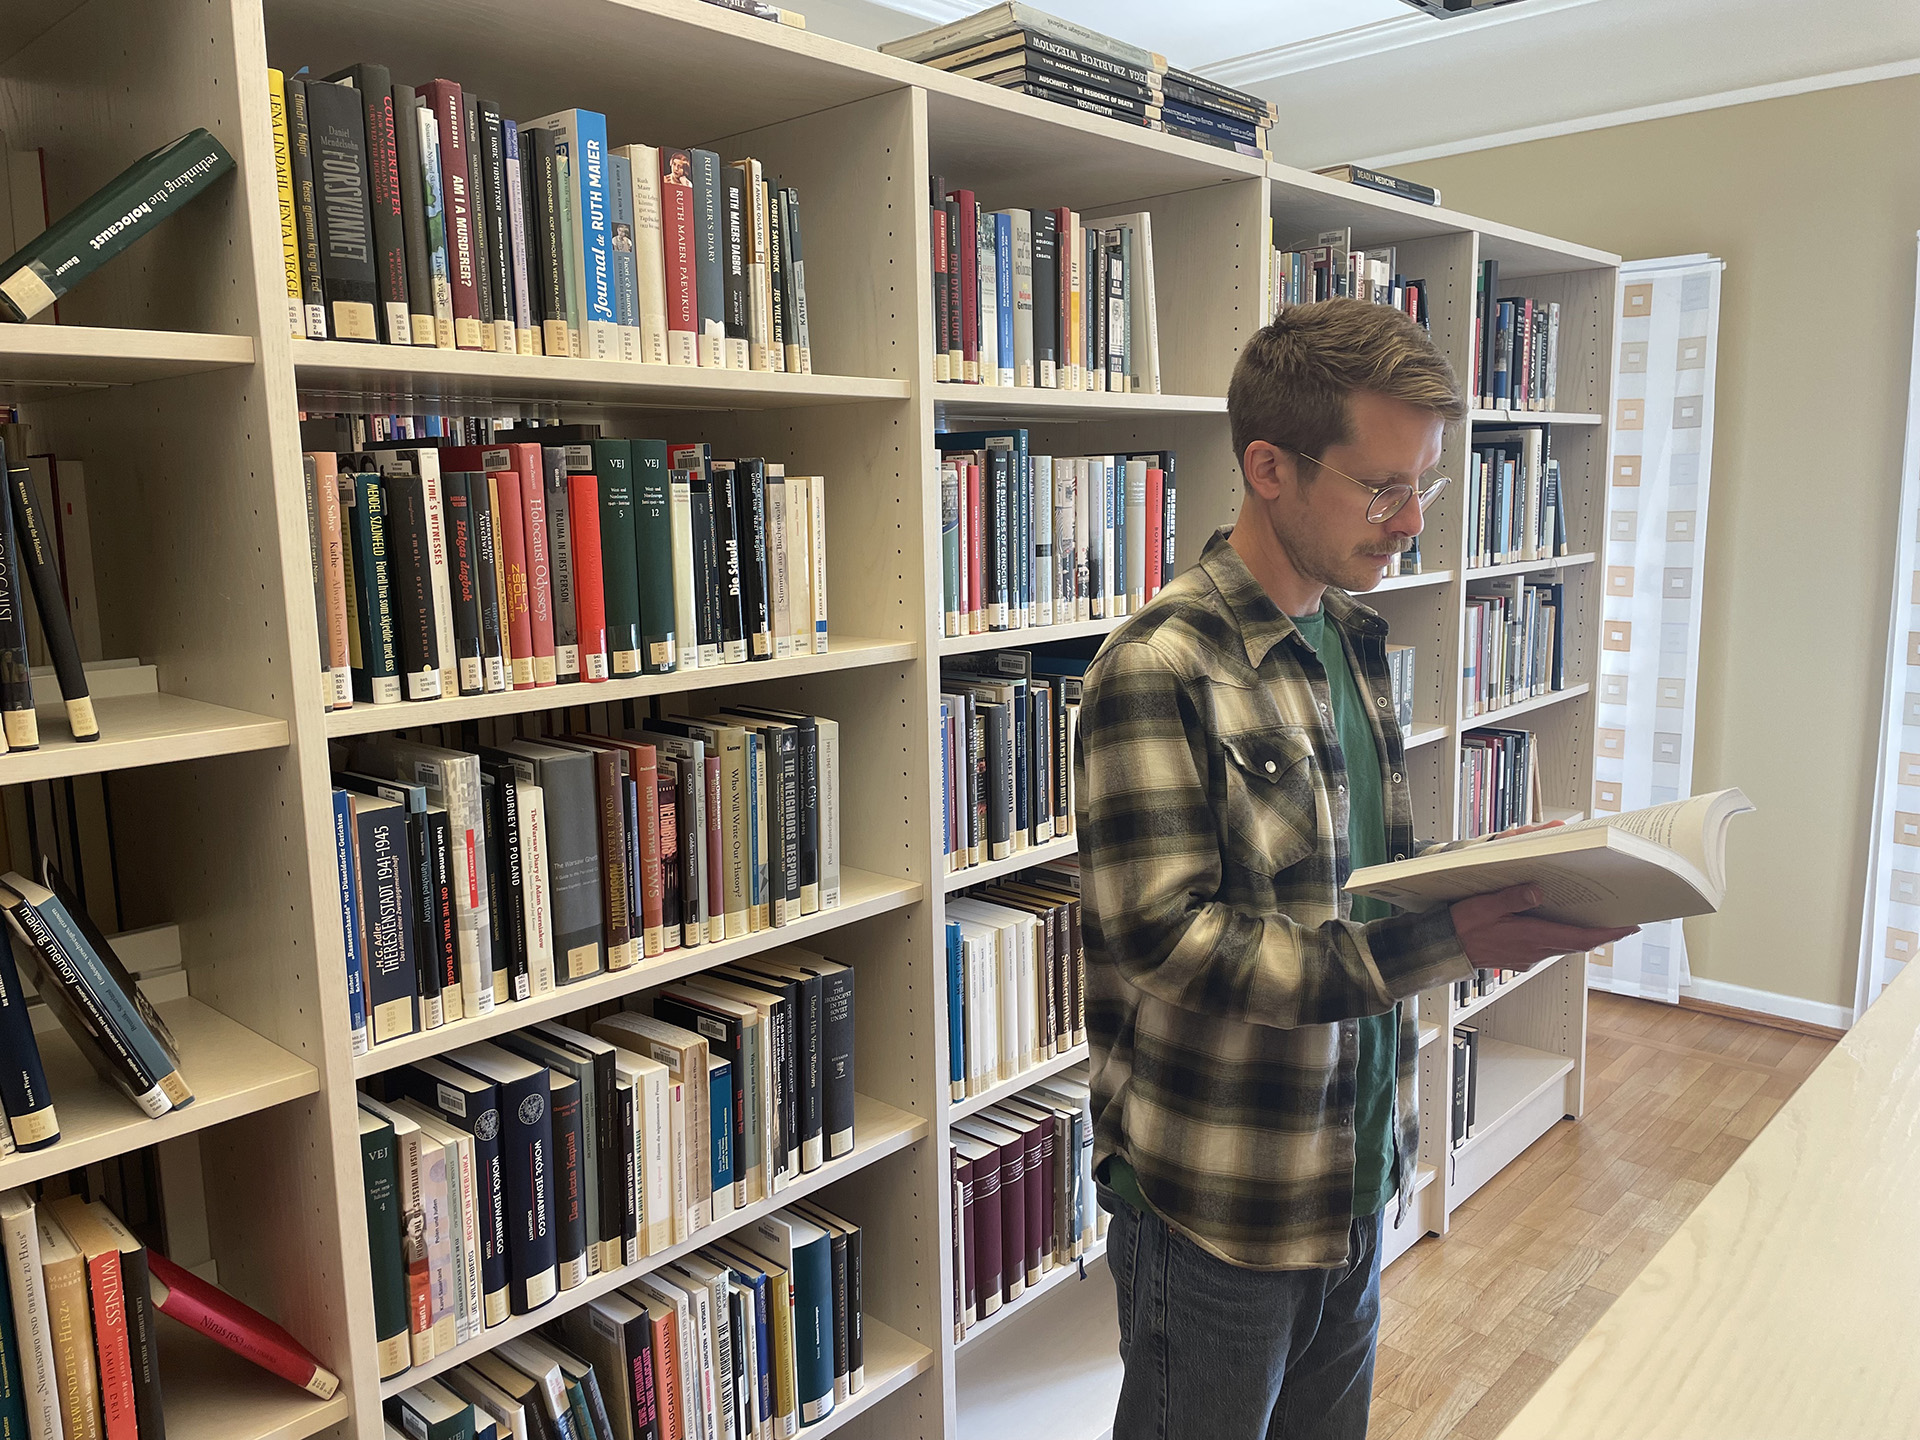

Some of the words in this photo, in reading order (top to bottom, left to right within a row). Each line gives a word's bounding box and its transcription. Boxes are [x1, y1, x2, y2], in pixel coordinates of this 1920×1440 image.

[1042, 57, 1053, 66] THE
[1054, 62, 1089, 77] AUSCHWITZ
[1090, 73, 1110, 84] ALBUM
[1039, 75, 1068, 90] AUSCHWITZ
[1073, 86, 1083, 94] THE
[1084, 88, 1110, 102] RESIDENCE
[1110, 95, 1116, 103] OF
[1117, 98, 1134, 109] DEATH
[1076, 98, 1112, 116] MAUTHAUSEN
[328, 125, 350, 138] Daniel
[449, 95, 459, 149] PERECHODNIK
[320, 136, 359, 150] Mendelsohn
[383, 96, 401, 216] COUNTERFEITER
[511, 128, 519, 158] palgrave
[164, 151, 220, 194] rethinking
[587, 139, 601, 187] MAIER
[148, 188, 169, 205] the
[1374, 175, 1396, 188] MEDICINE
[322, 150, 367, 263] FORSVUNNET
[589, 190, 605, 231] RUTH
[676, 190, 684, 222] RUTH
[706, 188, 714, 231] MAIER'S
[730, 187, 739, 210] RUTH
[771, 198, 779, 227] ROBERT
[88, 201, 153, 251] holocaust
[597, 234, 604, 246] de
[730, 211, 741, 243] MAIERS
[677, 224, 686, 264] MAIERI
[707, 232, 715, 264] DIARY
[772, 229, 780, 273] SAVOSNICK
[55, 255, 81, 277] Bauer
[731, 244, 741, 276] DAGBOK
[950, 253, 958, 276] DEN
[592, 248, 612, 318] Journal
[680, 266, 689, 322] PÄEVIKUD
[773, 288, 781, 302] JEG
[951, 278, 959, 306] DYRE
[774, 303, 782, 324] VILLE
[952, 309, 960, 342] FLUGT
[610, 459, 625, 469] VEJ
[644, 459, 660, 469] VEJ
[18, 482, 28, 505] WAXMAN
[366, 483, 381, 514] MENDEL
[427, 478, 440, 511] TIME'S
[25, 507, 36, 528] Writing
[530, 498, 545, 561] Holocaust
[555, 509, 565, 538] TRAUMA
[774, 501, 782, 550] Buchenwald
[31, 529, 39, 538] the
[369, 516, 385, 557] SZAJNFELD
[429, 514, 442, 565] WITNESSES
[455, 520, 468, 557] Helgas
[479, 513, 489, 560] Auschwitz
[556, 541, 566, 550] IN
[1001, 534, 1006, 545] OF
[32, 538, 44, 565] Holocaust
[412, 533, 421, 568] smoke
[557, 552, 568, 572] FIRST
[726, 539, 738, 575] Schuld
[375, 561, 388, 584] Fortell
[416, 576, 424, 600] over
[459, 561, 472, 602] dagbok
[511, 563, 522, 613] ZSOLT
[728, 577, 740, 596] Die
[777, 568, 785, 604] Stimmen
[377, 585, 389, 598] hva
[534, 565, 548, 622] Odysseys
[558, 574, 570, 603] PERSON
[379, 599, 389, 614] som
[381, 615, 393, 643] skjedde
[419, 608, 430, 659] birkenau
[383, 643, 394, 658] med
[386, 660, 394, 672] oss
[784, 758, 795, 778] THE
[806, 744, 816, 782] Secret
[731, 768, 740, 791] Who
[505, 783, 517, 828] JOURNEY
[605, 795, 614, 828] TOWN
[732, 794, 741, 812] Will
[785, 782, 796, 840] NEIGHBORS
[806, 785, 817, 809] City
[508, 831, 517, 844] TO
[659, 802, 677, 855] NEIGHBORS
[732, 813, 741, 839] Write
[373, 825, 392, 881] 1941-1945
[607, 831, 617, 862] NEAR
[733, 840, 741, 860] Our
[421, 860, 431, 894] Vanished
[510, 847, 520, 886] POLAND
[733, 861, 742, 898] History?
[786, 844, 797, 891] RESPOND
[391, 855, 403, 915] Zwangsgemeinschaft
[610, 863, 626, 930] AUSCHWITZ
[422, 896, 432, 923] History
[19, 905, 51, 946] making
[44, 943, 78, 986] memory
[373, 922, 383, 946] Adler
[378, 885, 399, 975] THERESIENSTADT
[375, 947, 384, 968] H.G.
[810, 1020, 818, 1034] His
[809, 1036, 818, 1052] Very
[810, 1053, 818, 1088] Windows
[26, 1088, 36, 1108] Katrin
[368, 1146, 389, 1161] VEJ
[534, 1139, 545, 1175] WOKÓŁ
[565, 1131, 577, 1169] Kapital
[462, 1154, 470, 1199] TREBLINKA
[491, 1155, 503, 1191] WOKÓŁ
[567, 1170, 577, 1199] letzte
[464, 1200, 472, 1209] IN
[535, 1175, 546, 1237] JEDWABNEGO
[568, 1202, 579, 1222] Das
[464, 1210, 473, 1241] REVOLT
[492, 1192, 504, 1254] JEDWABNEGO
[468, 1250, 477, 1300] WILLENBERG
[662, 1322, 671, 1365] LITAUEN
[717, 1321, 729, 1338] THE
[104, 1343, 118, 1388] SAMUEL
[666, 1366, 672, 1379] IN
[719, 1339, 731, 1380] HOLOCAUST
[721, 1380, 731, 1389] IN
[109, 1393, 121, 1422] DRIX
[666, 1381, 676, 1440] HOLOCAUST
[722, 1391, 733, 1416] LATVIA
